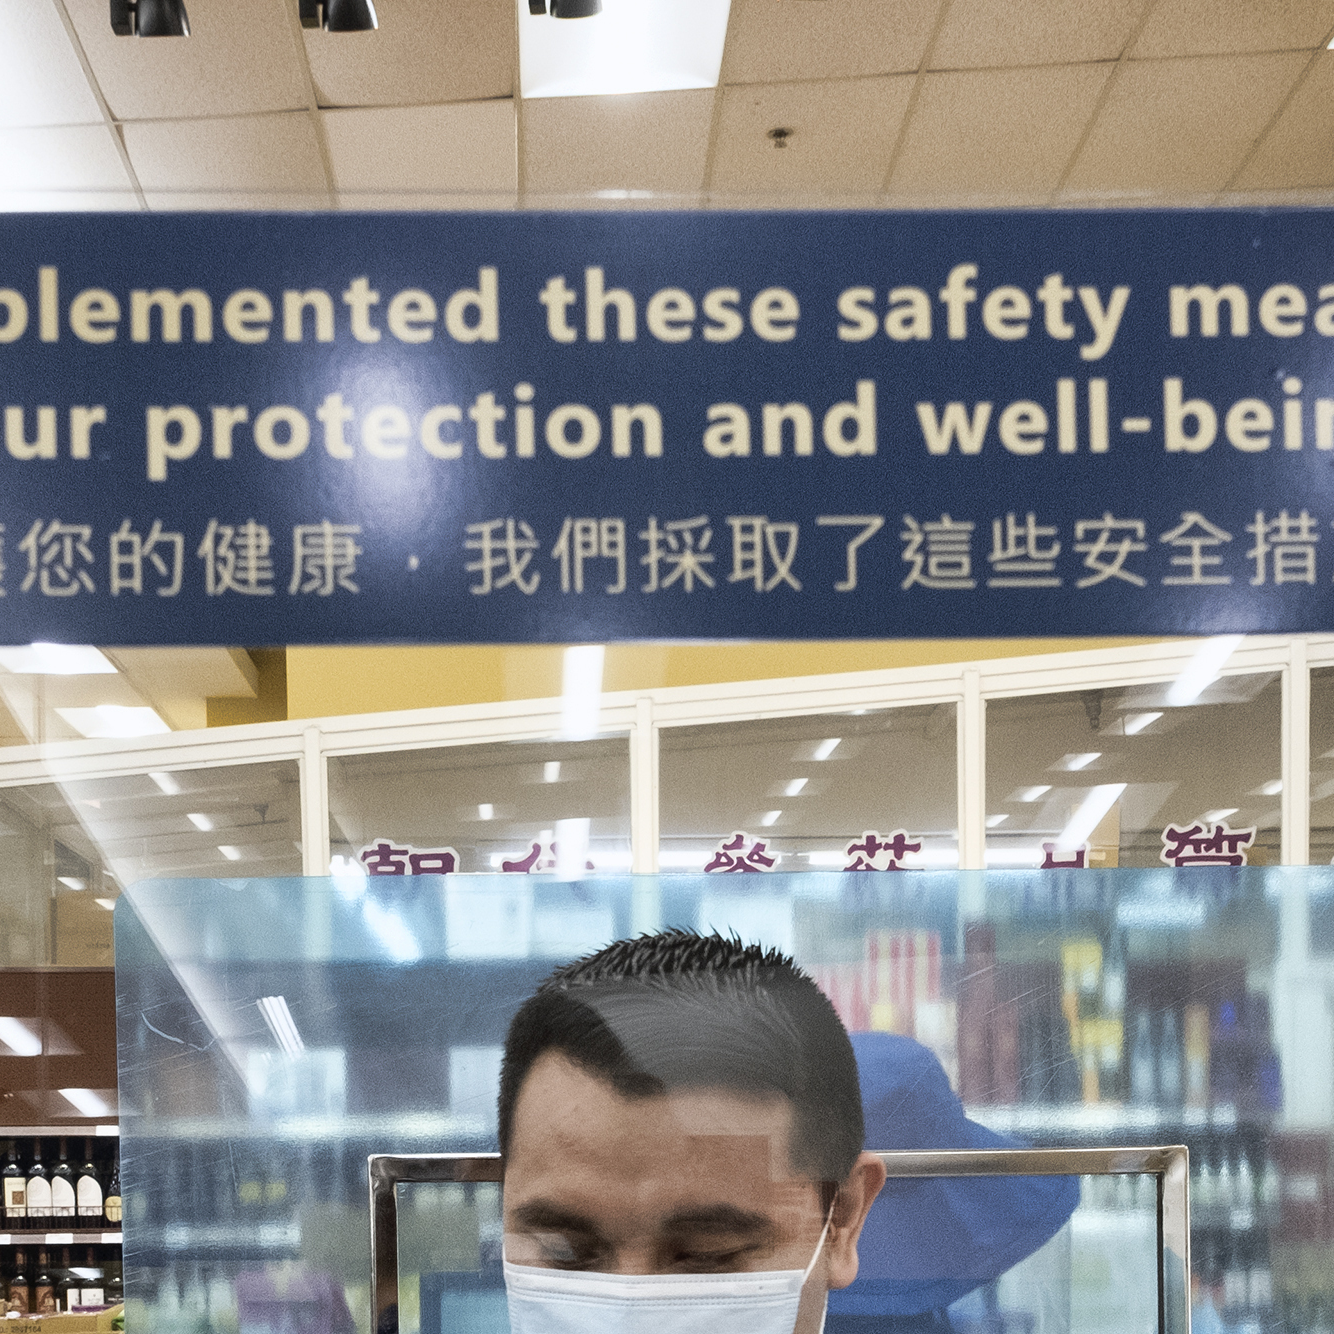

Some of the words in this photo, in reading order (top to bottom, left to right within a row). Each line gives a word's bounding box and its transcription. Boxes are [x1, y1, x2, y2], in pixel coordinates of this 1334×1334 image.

[538, 266, 800, 344] these
[835, 262, 1131, 362] safety
[146, 381, 664, 482] protection
[702, 379, 877, 458] and
